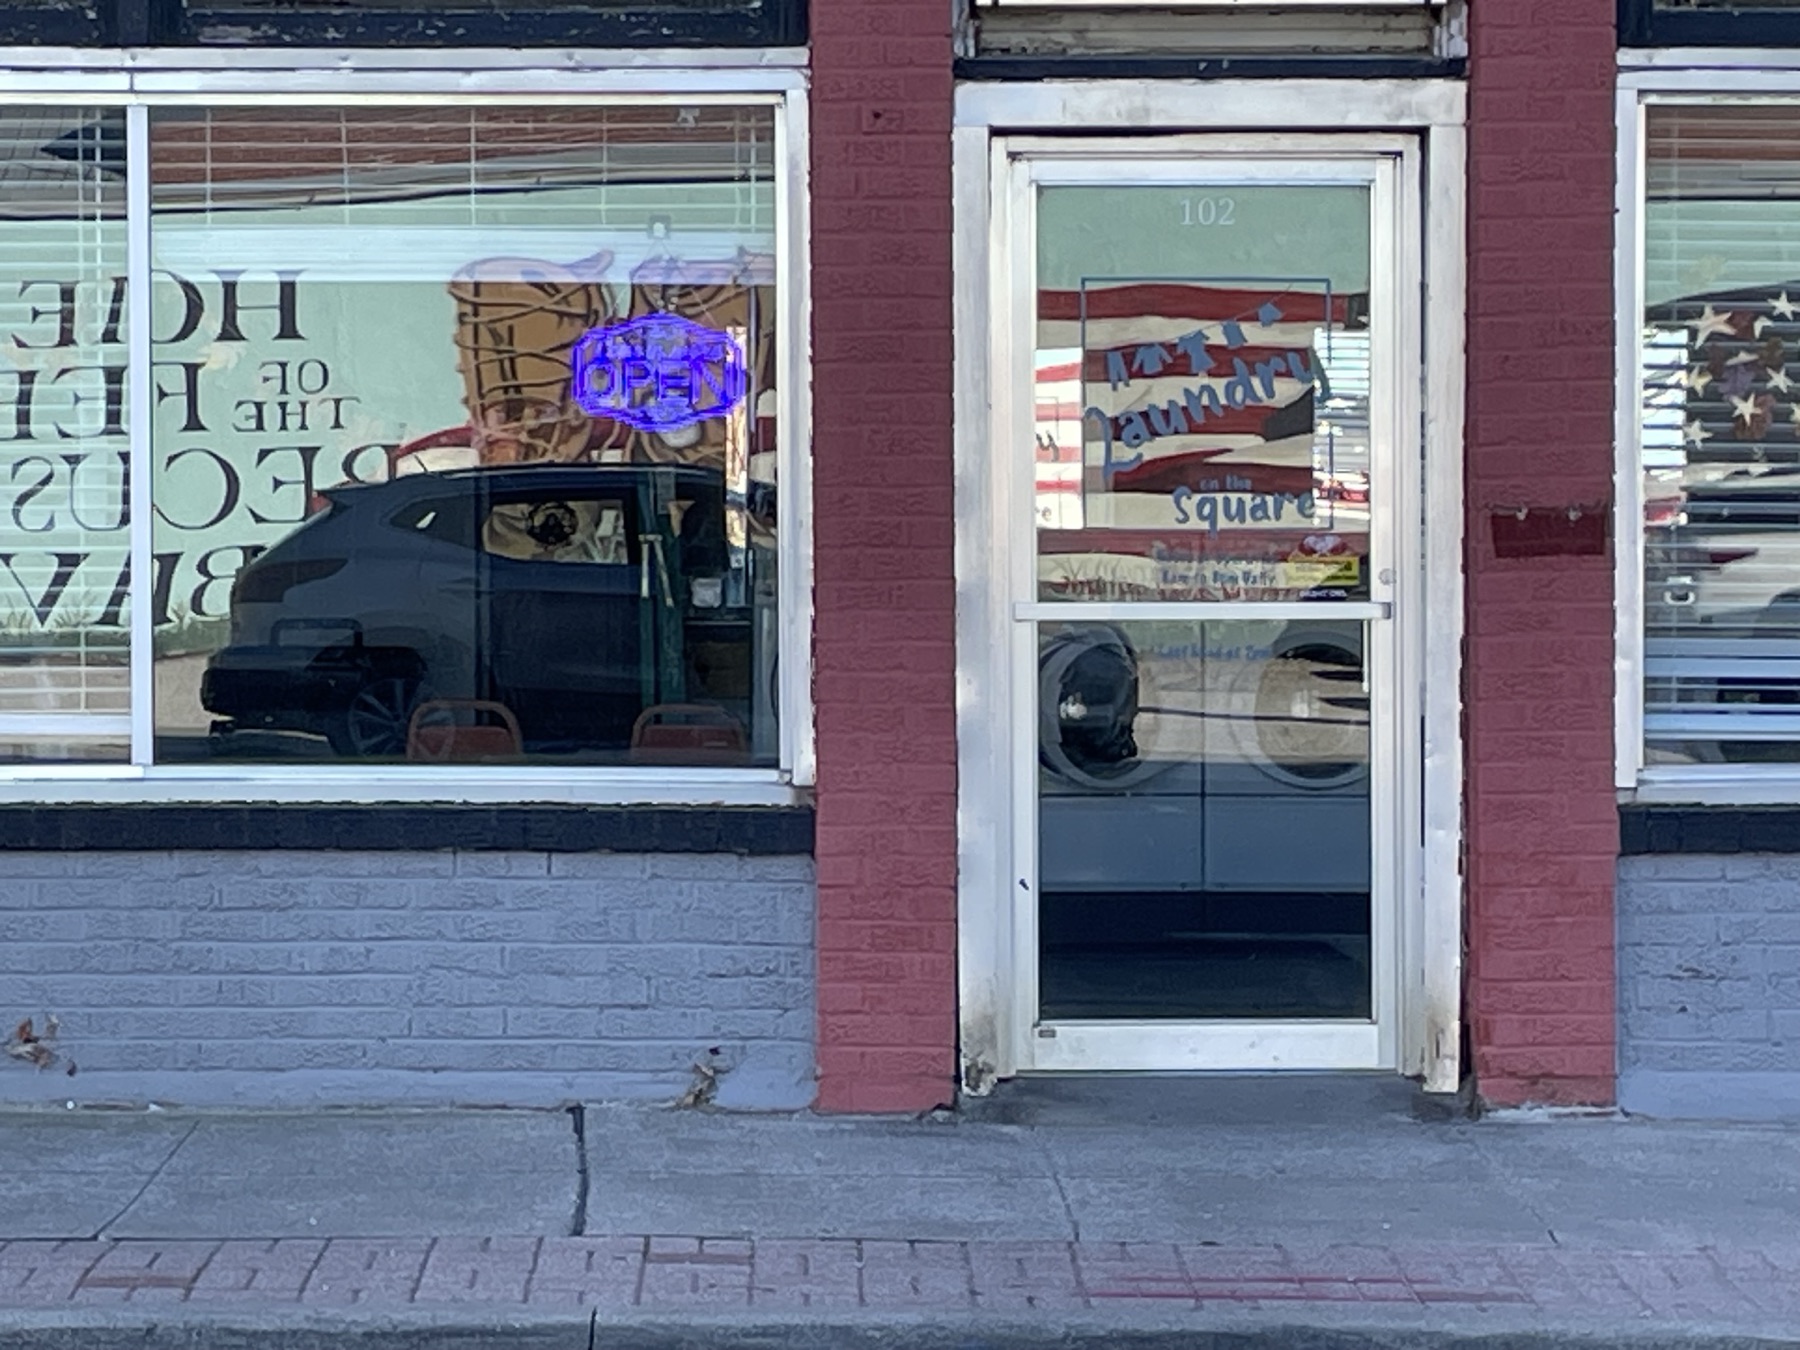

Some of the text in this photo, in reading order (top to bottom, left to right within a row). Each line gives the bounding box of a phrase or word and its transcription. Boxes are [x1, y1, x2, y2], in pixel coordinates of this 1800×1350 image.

[1179, 197, 1237, 227] 102
[584, 361, 736, 404] OPEN
[1083, 351, 1331, 483] Laundry
[1172, 486, 1318, 539] Square
